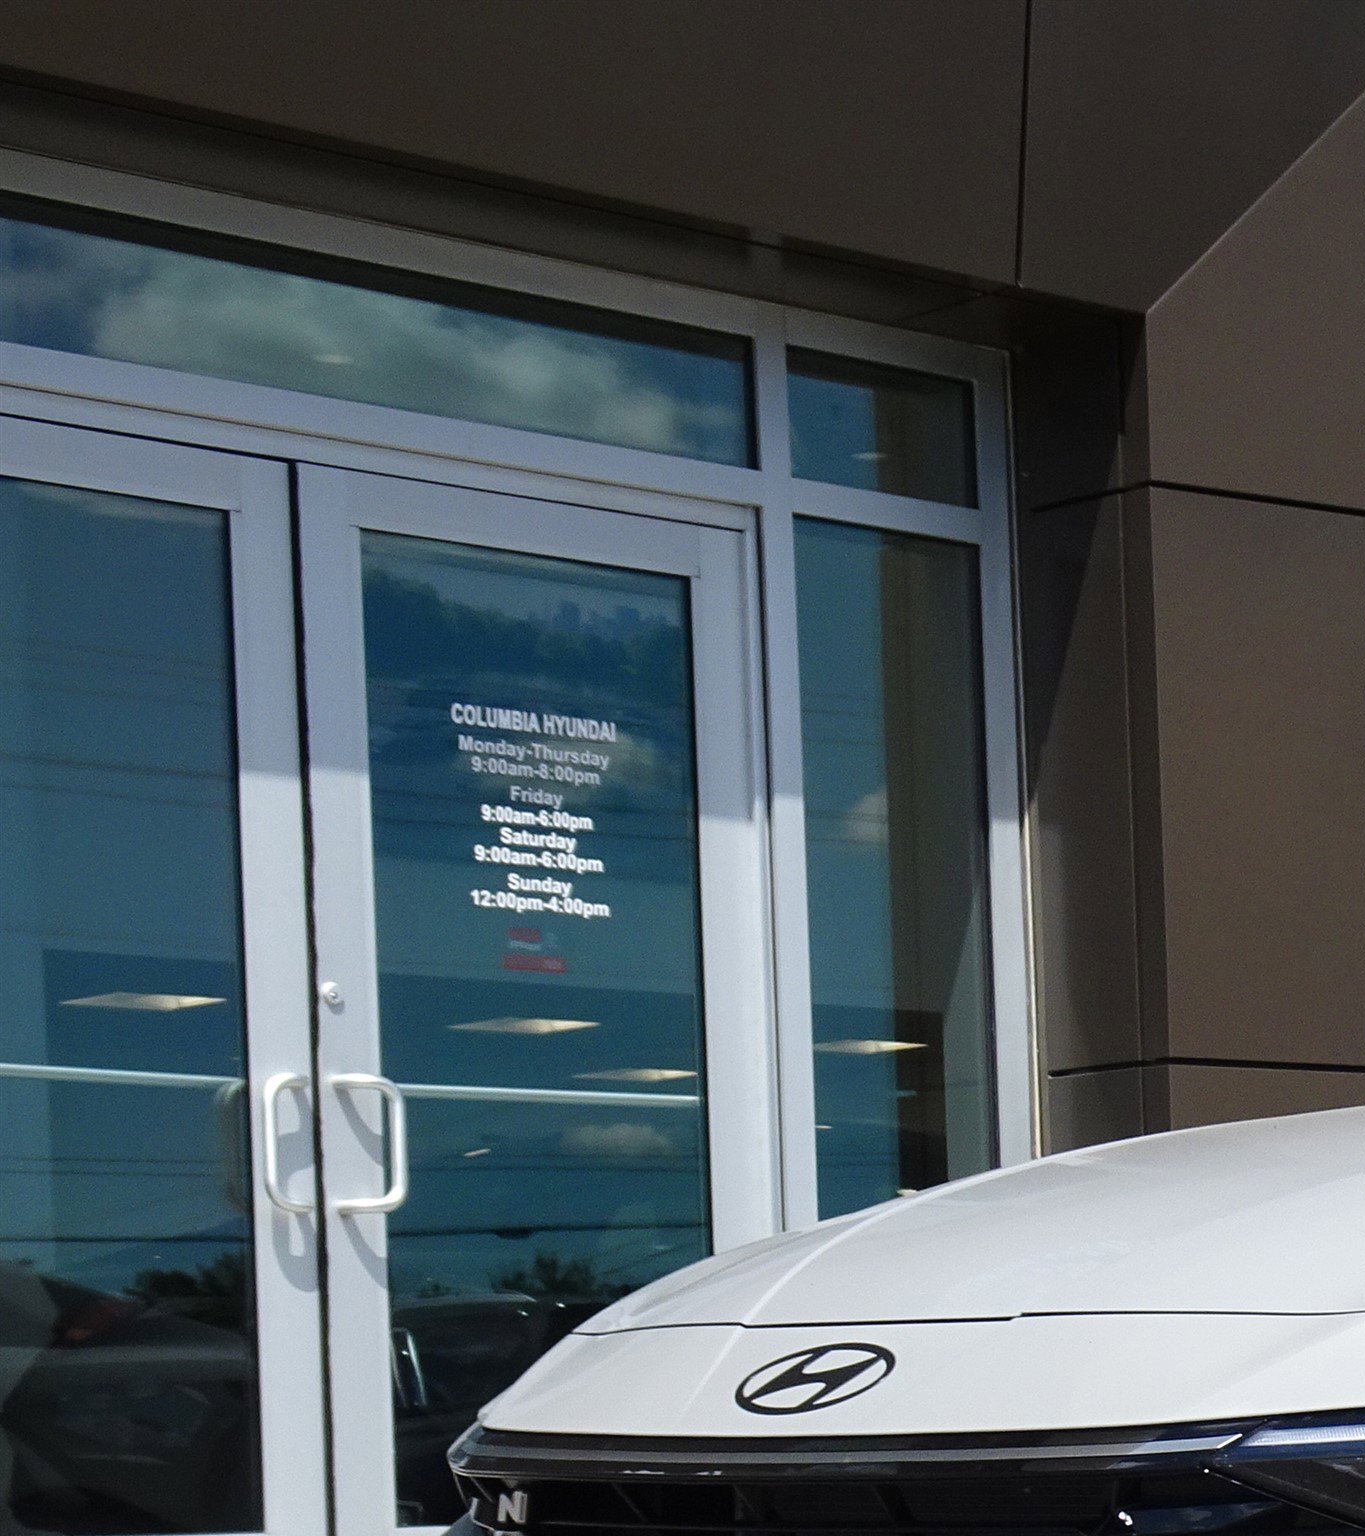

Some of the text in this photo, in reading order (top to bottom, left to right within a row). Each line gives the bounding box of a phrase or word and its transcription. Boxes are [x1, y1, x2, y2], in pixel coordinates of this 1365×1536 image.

[451, 702, 617, 743] COLUMBIA HYUNDAI
[458, 734, 610, 770] Monday-Thursday
[471, 756, 601, 786] 9:00am-8:00pm
[510, 785, 564, 810] Friday
[480, 804, 593, 831] 9:00am-6:00pm
[500, 826, 577, 854] Saturday
[473, 844, 604, 873] 9:00am-6:00pm
[507, 872, 573, 898] Sunday
[470, 889, 610, 918] 12:00pm-4:00pm
[498, 1490, 528, 1525] N
